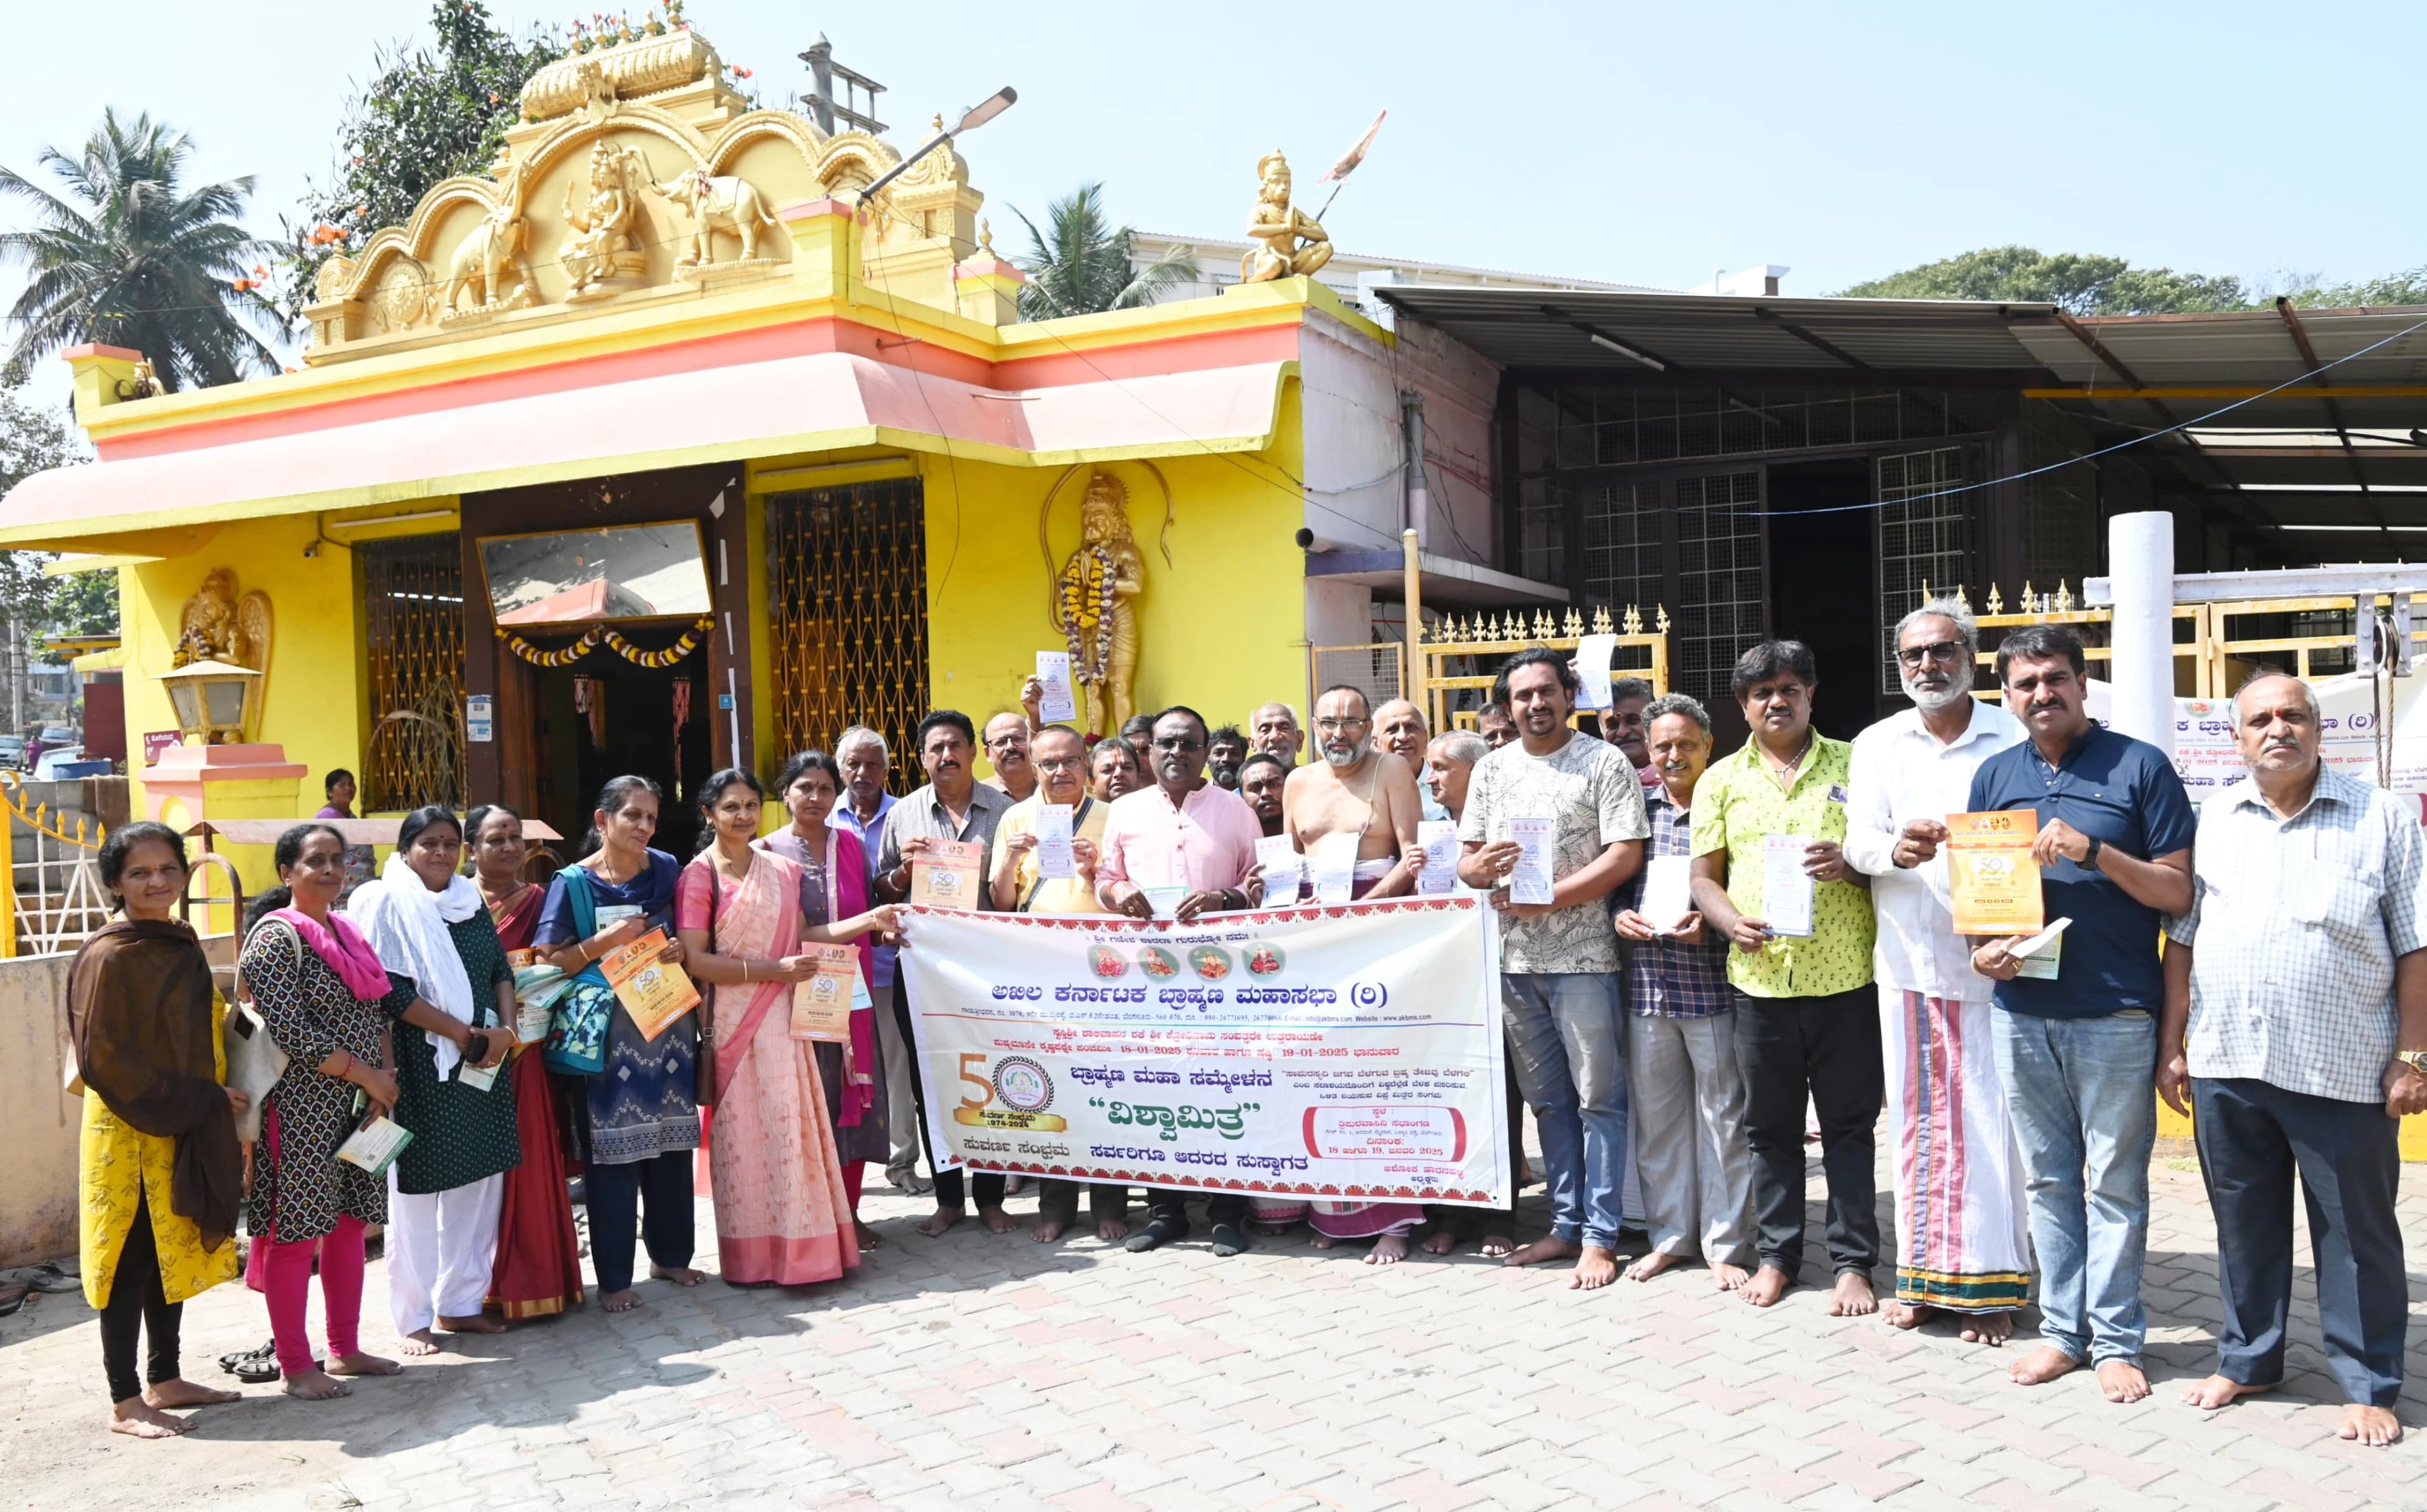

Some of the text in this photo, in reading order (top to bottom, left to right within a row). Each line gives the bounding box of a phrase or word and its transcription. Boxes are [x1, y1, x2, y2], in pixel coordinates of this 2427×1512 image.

[992, 981, 1388, 1013] ಅಖಿಲ ಕರ್ನಾಟಕ ಬ್ರಾಹ್ಮಣ ಮಹಾಸಭಾ (ರಿ)
[1383, 1013, 1432, 1022] www.akbms.com
[1121, 1046, 1181, 1055] 18-01-2025
[1282, 1048, 1348, 1057] 19-01-2025
[1070, 1064, 1273, 1094] ಬ್ರಾಹ್ಮಣ ಮಹಾ ಸಮ್ಮೇಳನ
[987, 1120, 1029, 1128] 1974-2024
[1089, 1096, 1260, 1141] “ವಿಶ್ವಾಮಿತ್ರ”
[963, 1136, 1069, 1159] ಸುವರ್ಣ ಸಂಭ್ರಮ
[1420, 1147, 1444, 1156] 2025
[1090, 1144, 1308, 1176] ಸರ್ವರಿಗೂ ಆದರದ ಸುಸ್ವಾಗತ
